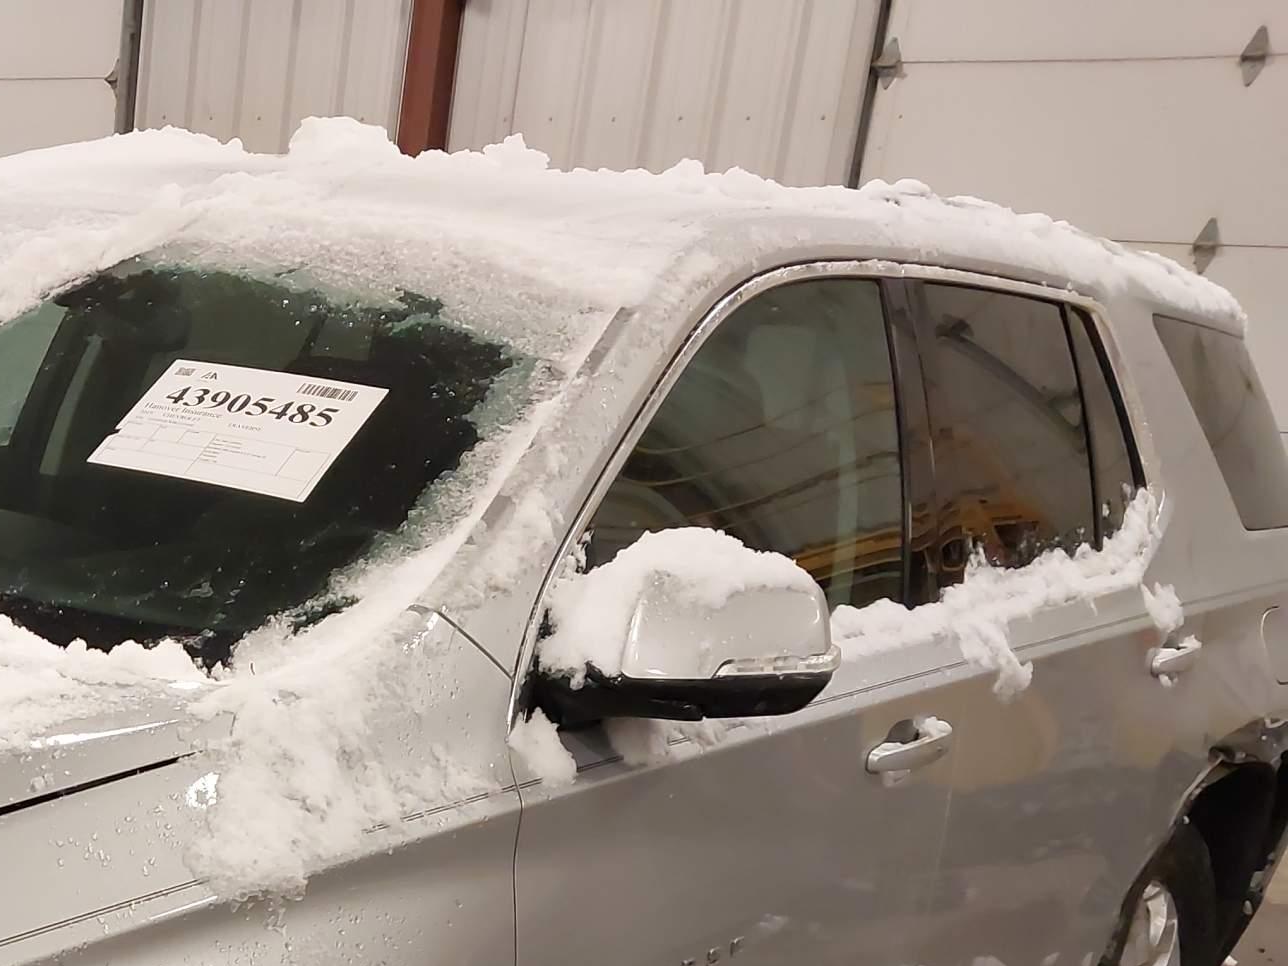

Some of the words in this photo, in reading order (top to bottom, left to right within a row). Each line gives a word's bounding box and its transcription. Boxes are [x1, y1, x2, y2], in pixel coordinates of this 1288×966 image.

[144, 402, 181, 414] Hanover
[181, 406, 223, 419] Insurance
[165, 385, 343, 429] 43905485
